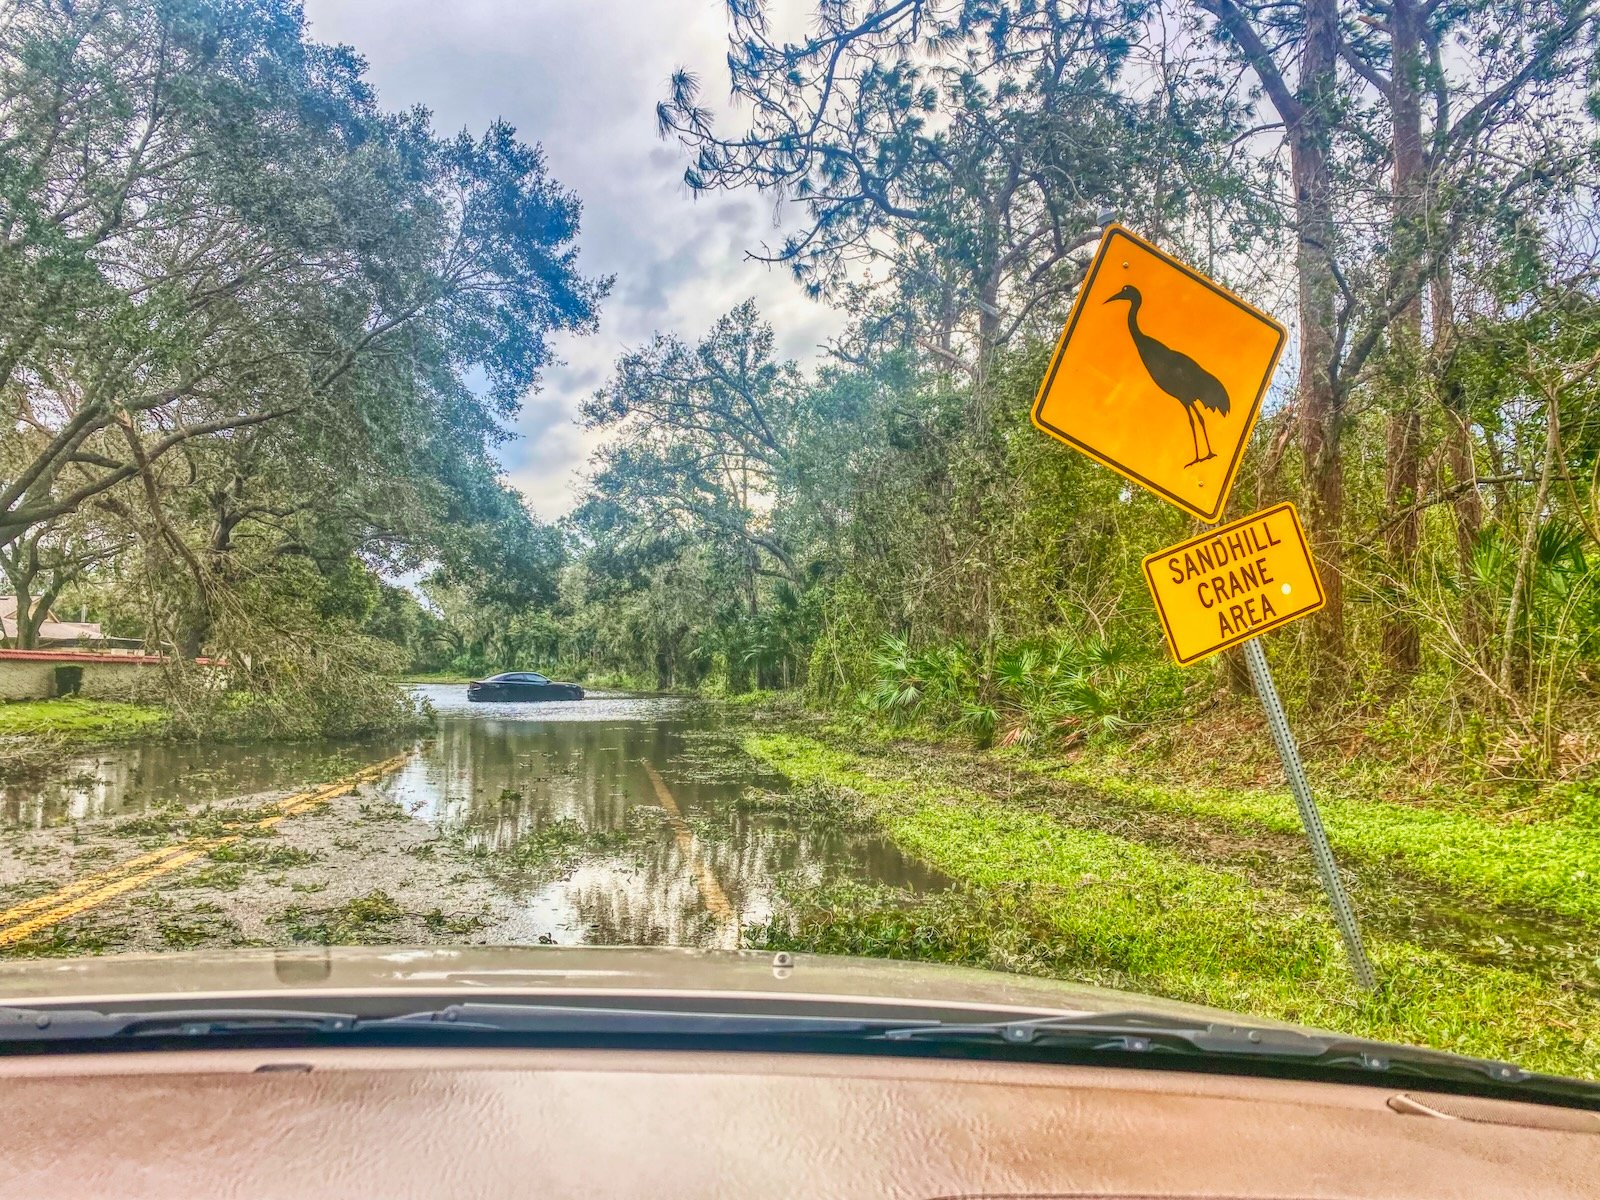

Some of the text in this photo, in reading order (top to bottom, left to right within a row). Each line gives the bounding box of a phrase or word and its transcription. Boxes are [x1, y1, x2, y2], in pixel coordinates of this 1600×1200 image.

[1168, 522, 1281, 584] SANDHILL
[1198, 558, 1274, 609] CRANE
[1218, 594, 1277, 638] AREA
